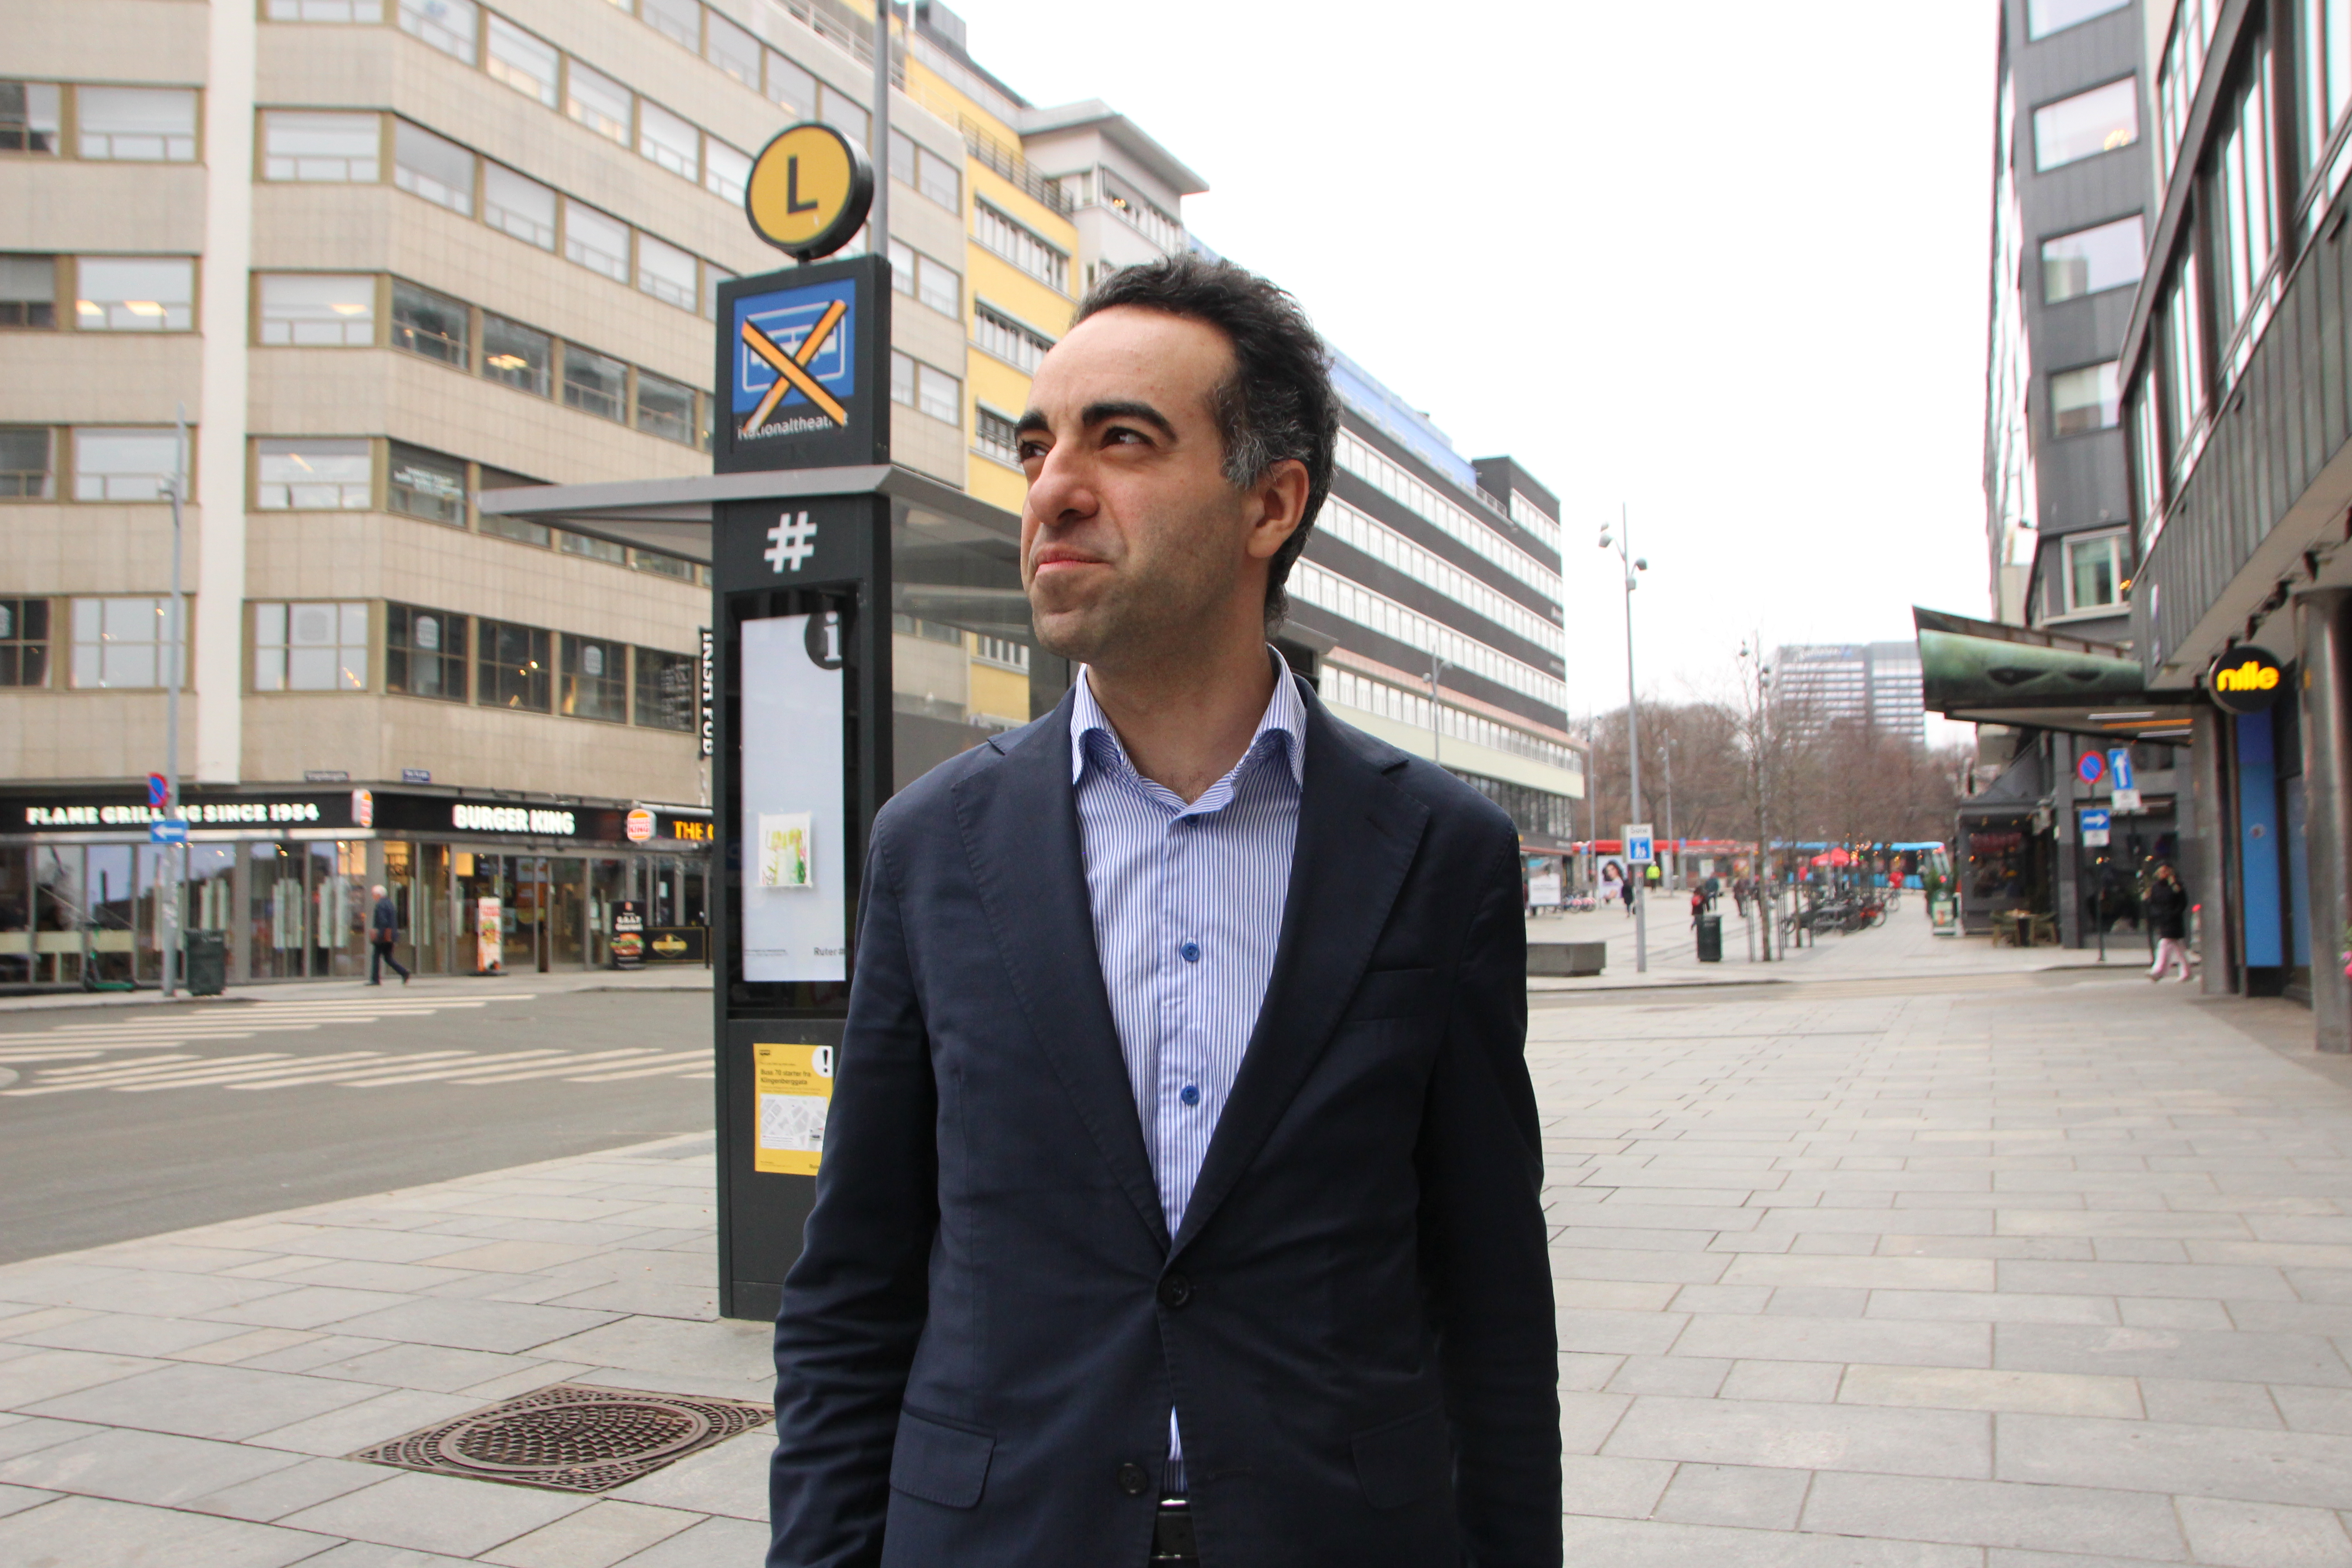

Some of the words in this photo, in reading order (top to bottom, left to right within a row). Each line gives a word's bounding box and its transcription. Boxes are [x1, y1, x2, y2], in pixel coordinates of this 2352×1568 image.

[788, 154, 818, 214] L
[764, 511, 817, 573] #
[824, 611, 842, 662] i
[2217, 661, 2280, 692] nille
[26, 806, 99, 825] FLAME
[100, 805, 202, 824] GRILLNG
[203, 804, 268, 823] SINCE
[269, 803, 320, 822] 1954
[453, 804, 529, 832] BURGER
[529, 809, 575, 835] KING
[673, 821, 704, 841] THE
[814, 947, 837, 956] Ruter
